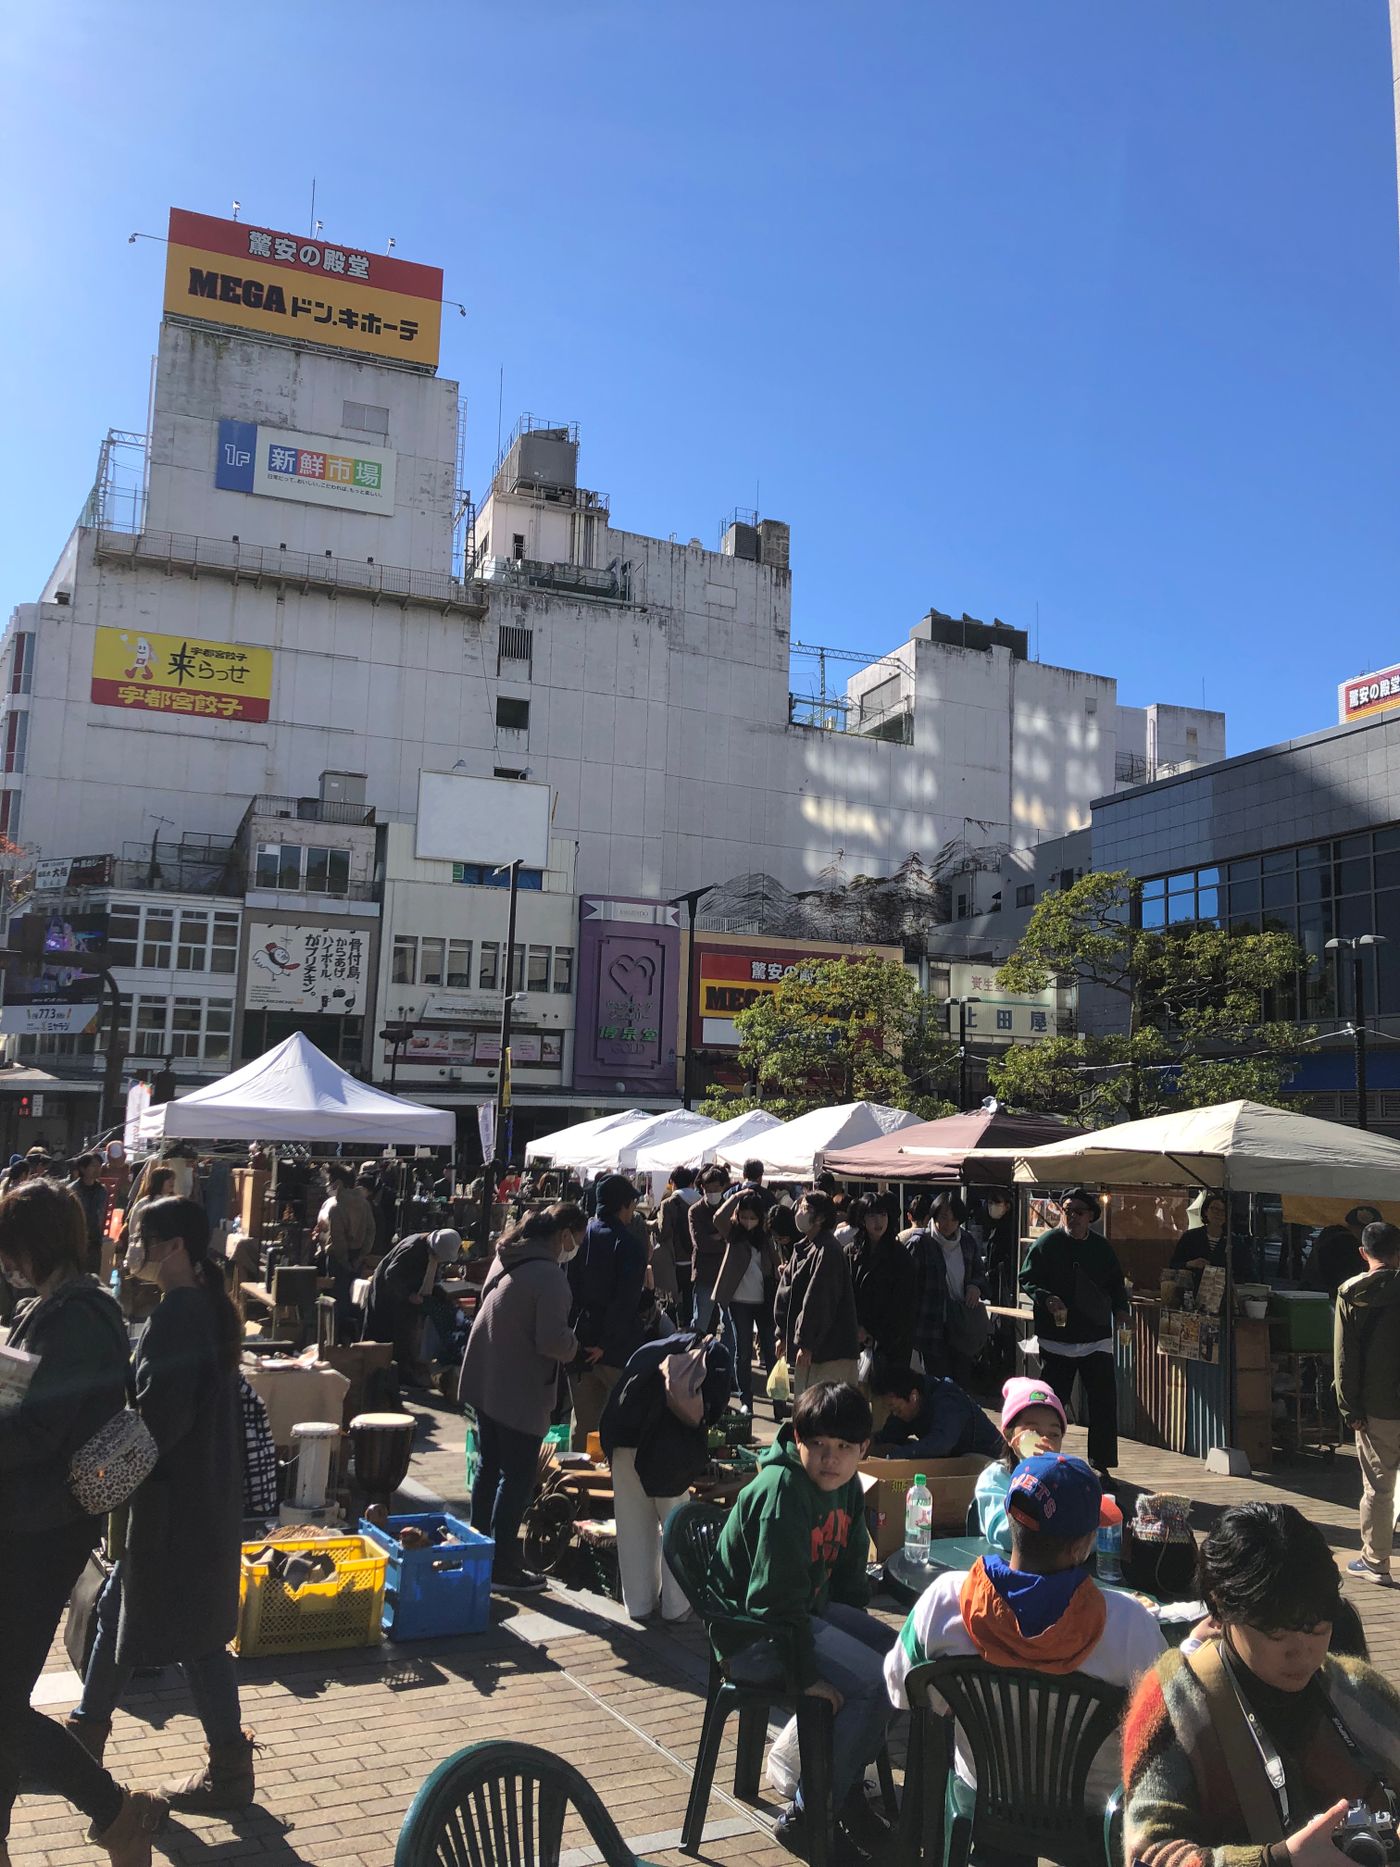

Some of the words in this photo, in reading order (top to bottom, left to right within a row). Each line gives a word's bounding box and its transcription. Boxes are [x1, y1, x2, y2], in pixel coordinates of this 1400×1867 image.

[248, 230, 370, 280] 驚安の殿堂
[188, 267, 287, 315] MEGA
[225, 443, 250, 467] 1F
[271, 447, 380, 487] 新鮮市場
[168, 641, 251, 686] 来らっせ
[190, 646, 248, 662] 宇都宮餃子
[118, 685, 243, 716] 宇都宮餃子
[1350, 674, 1400, 708] 驚安の殿堂
[320, 935, 335, 981] ハイボール、
